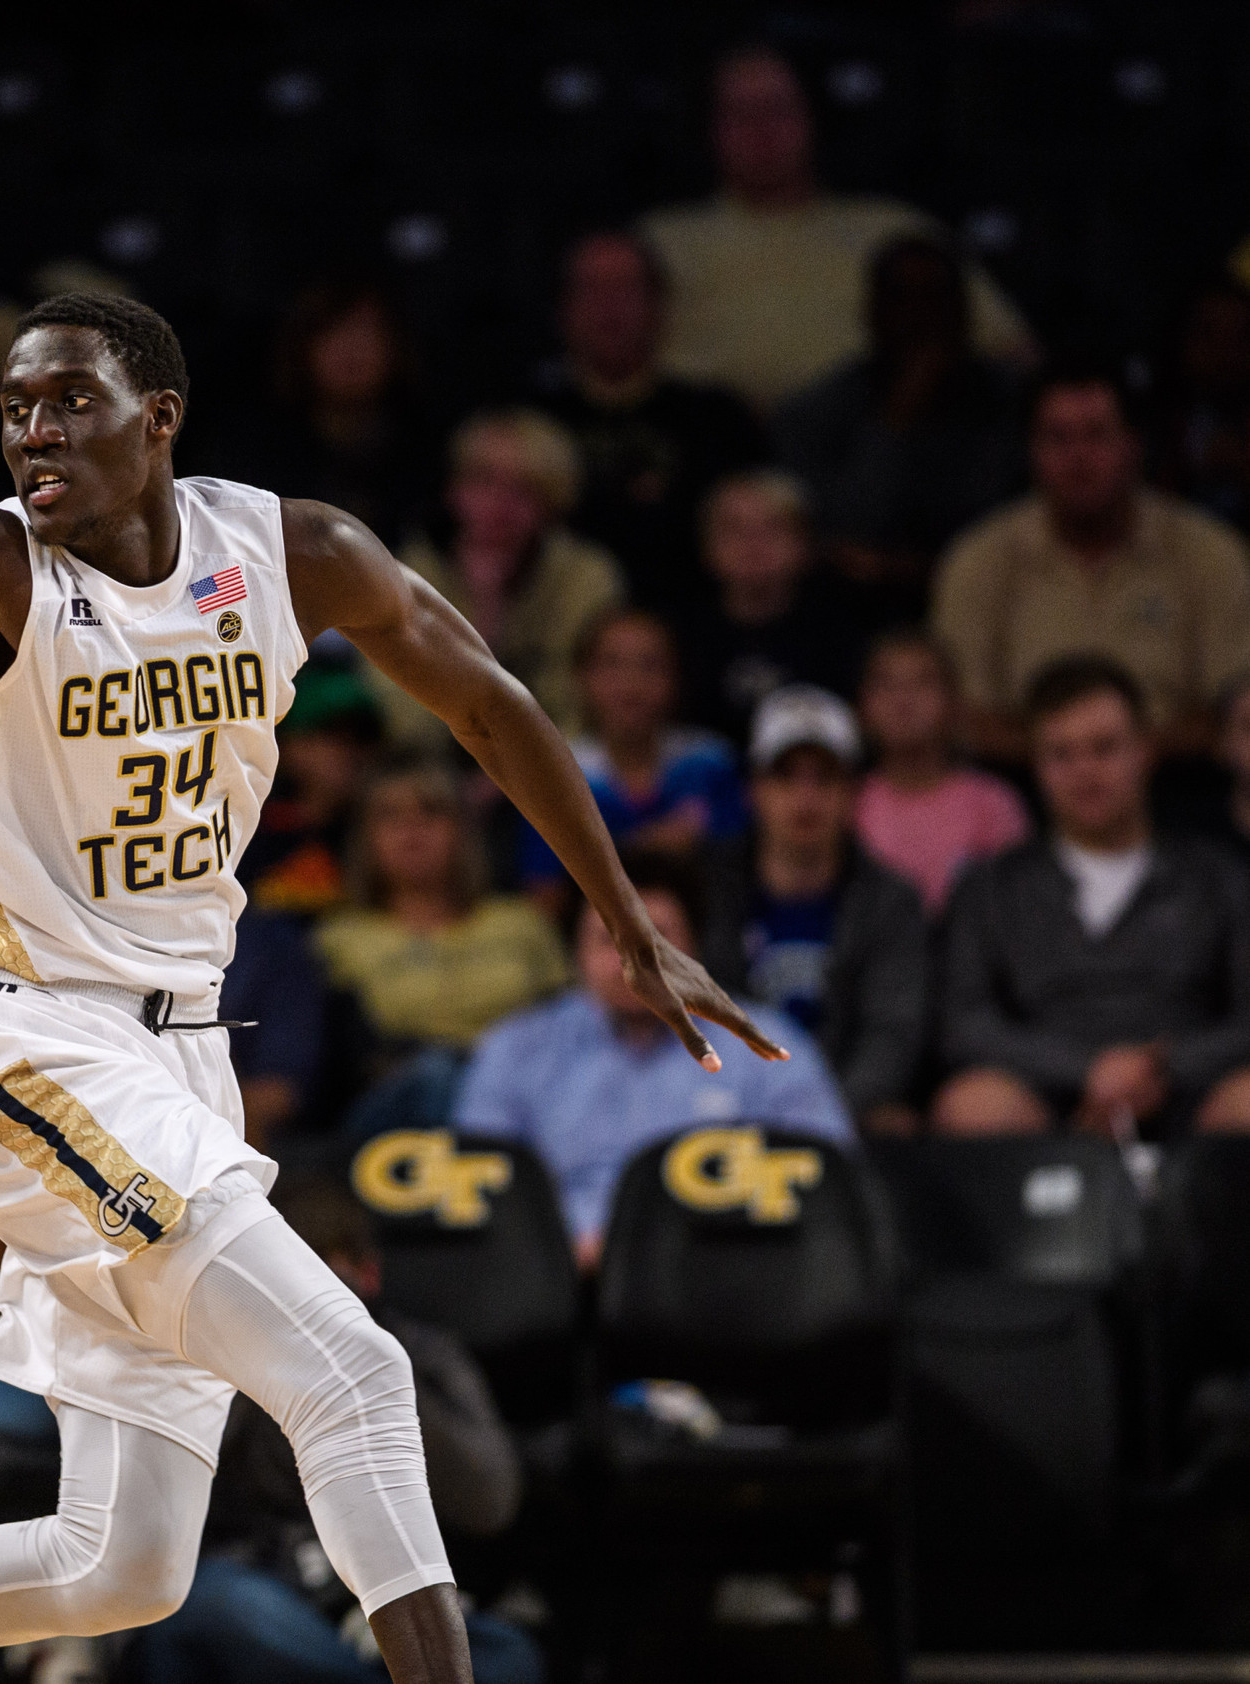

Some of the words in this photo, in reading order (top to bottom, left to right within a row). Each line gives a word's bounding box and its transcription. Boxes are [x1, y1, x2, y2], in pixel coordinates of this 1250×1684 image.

[69, 618, 102, 626] RUSSELL
[57, 651, 267, 739] GEORGIA
[111, 725, 219, 830] 34
[77, 794, 232, 900] TECH
[97, 1172, 157, 1237] GT
